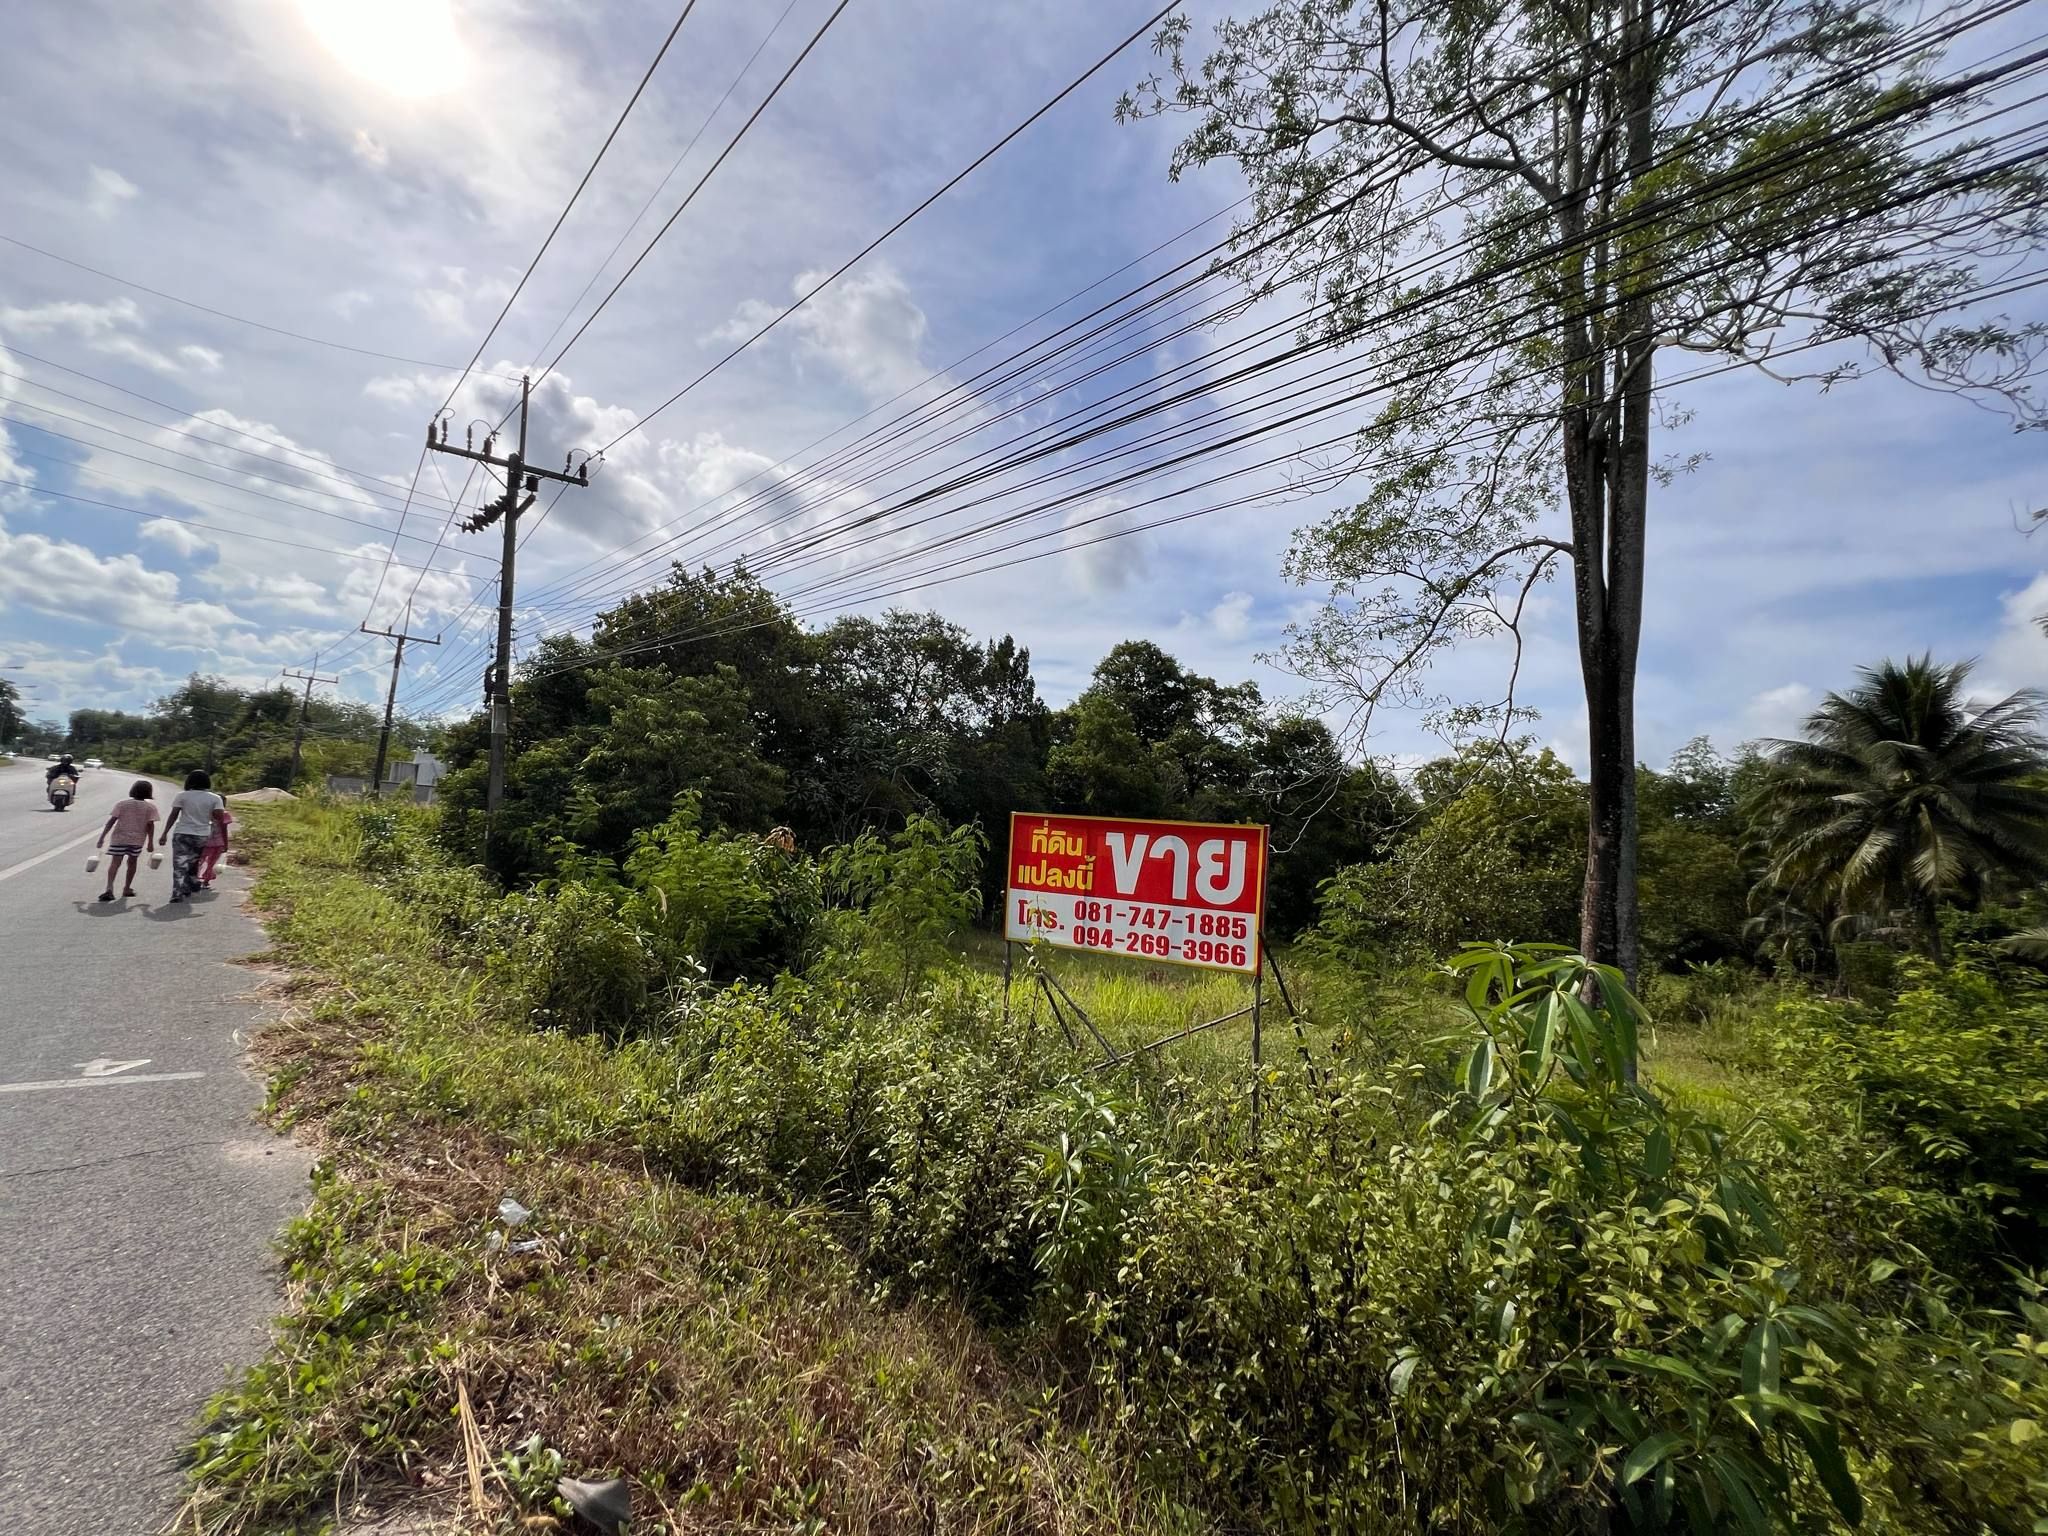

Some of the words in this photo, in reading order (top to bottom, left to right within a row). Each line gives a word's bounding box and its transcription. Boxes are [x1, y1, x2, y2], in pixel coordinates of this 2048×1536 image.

[1031, 820, 1083, 856] ที่ดิน
[1018, 855, 1096, 890] แปลงนี้
[1106, 832, 1246, 905] ขาย
[1074, 900, 1247, 940] 081-747-1885
[1073, 926, 1246, 966] 094-269-3966
